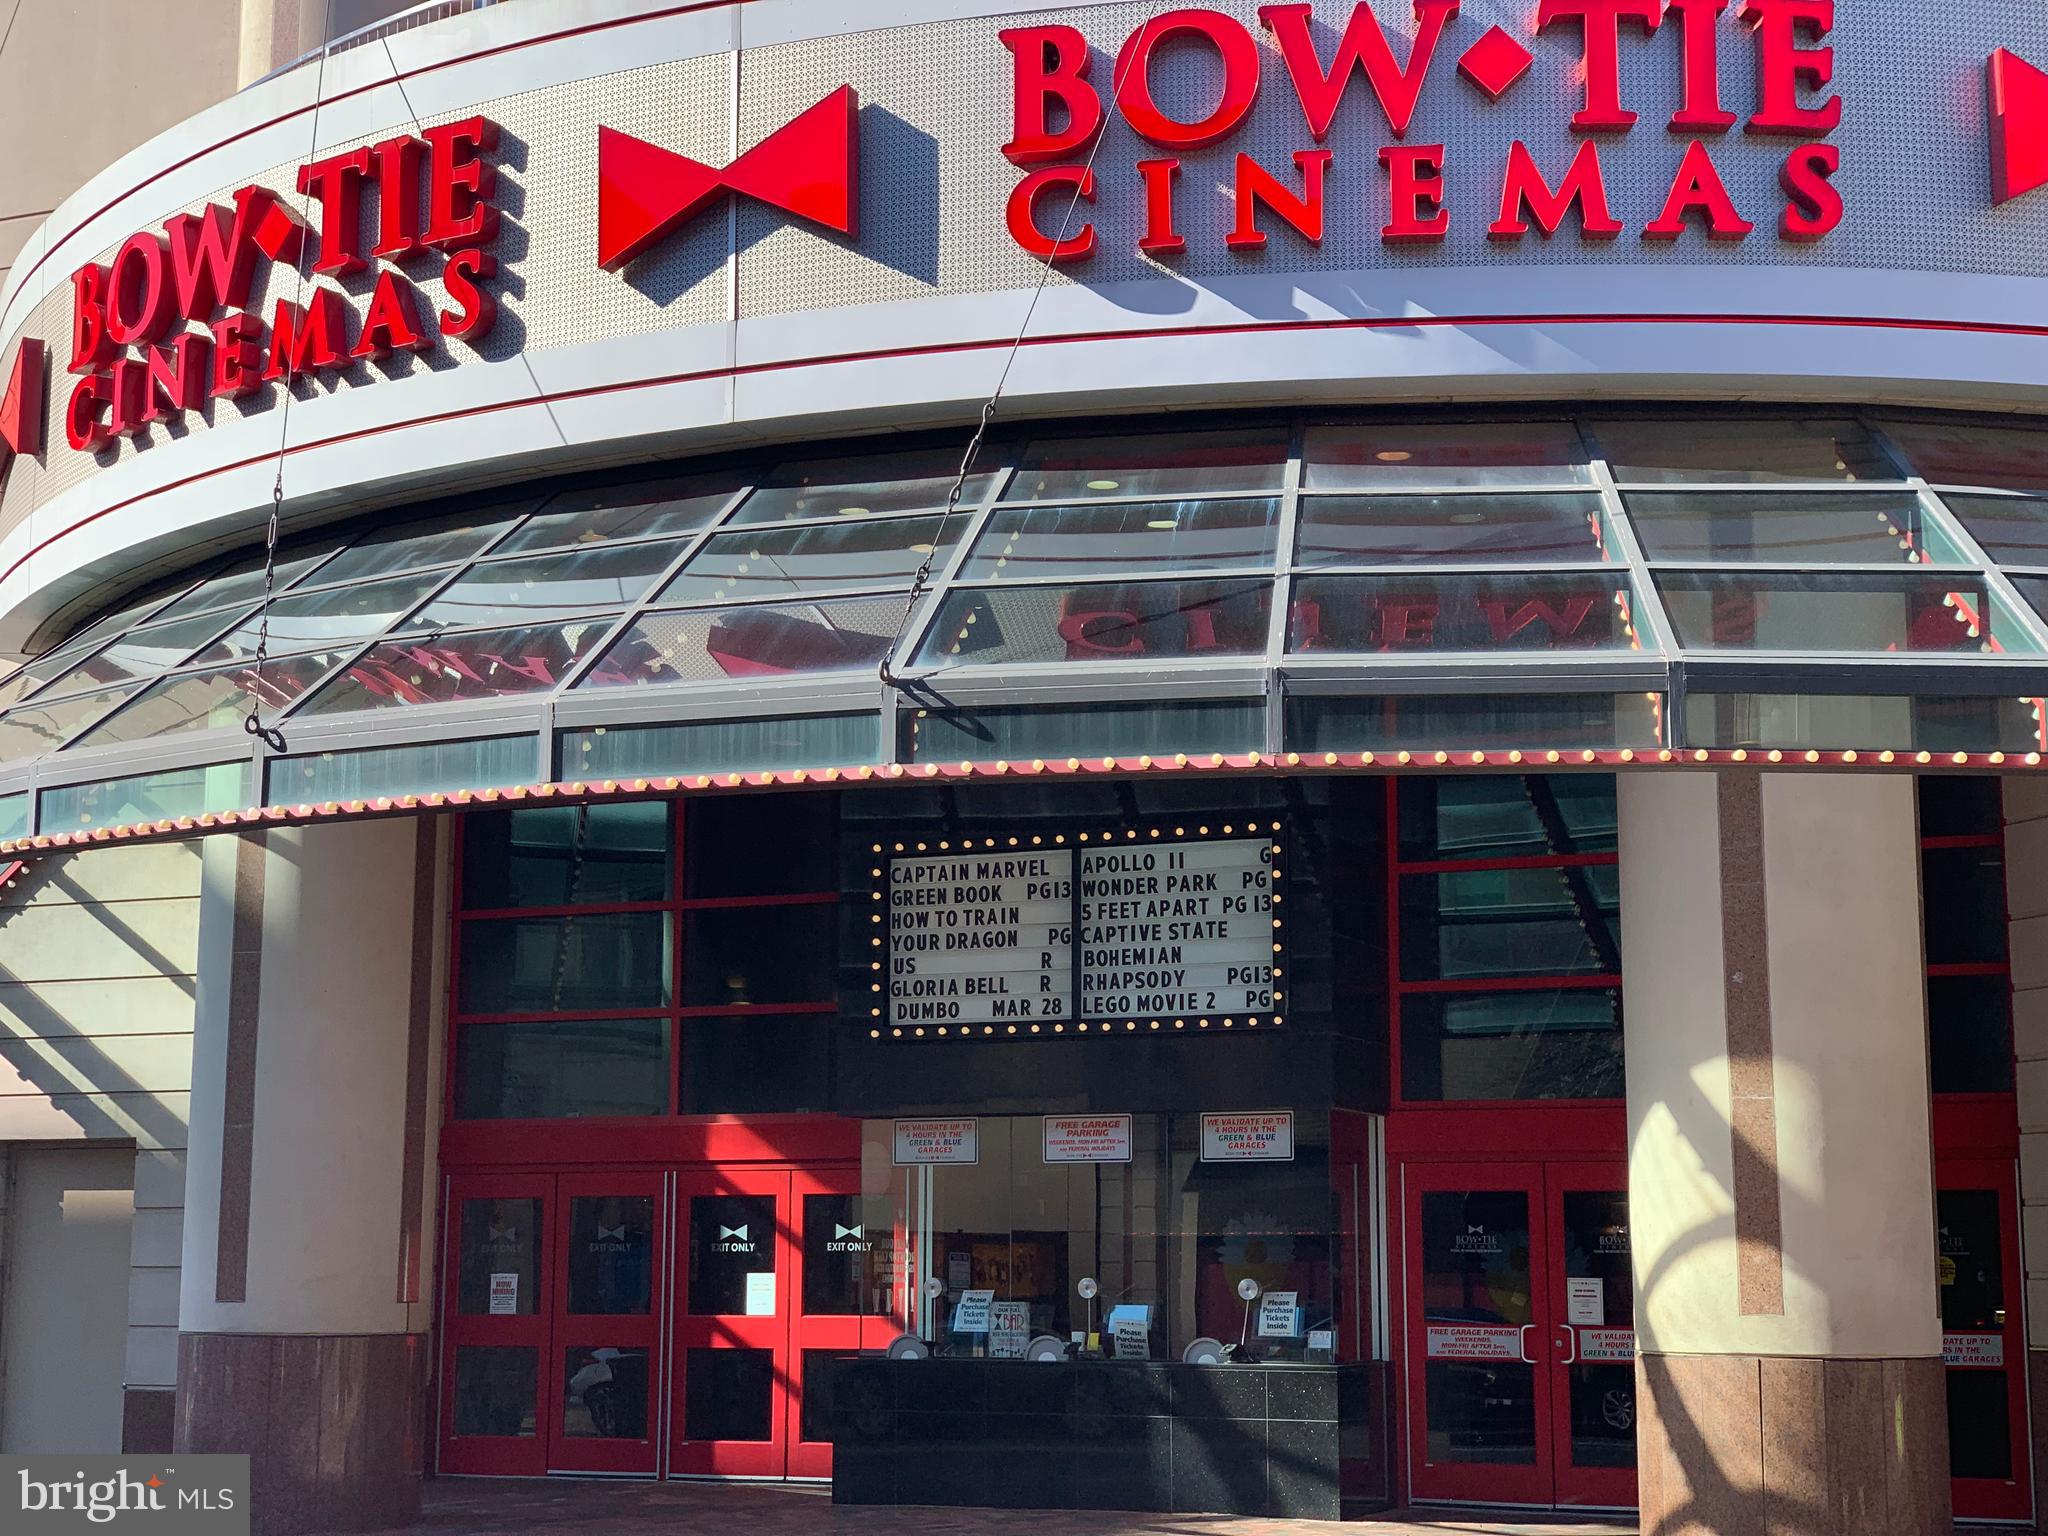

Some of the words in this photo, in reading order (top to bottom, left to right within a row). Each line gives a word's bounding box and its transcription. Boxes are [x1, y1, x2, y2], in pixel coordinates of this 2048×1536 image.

[1005, 139, 1843, 261] CINEMAS
[66, 249, 497, 452] CINEMAS
[1082, 853, 1156, 874] APOLLO
[1260, 846, 1272, 864] G
[891, 863, 969, 884] CAPTAIN
[977, 859, 1050, 880] MARVEL
[891, 887, 947, 906] GREEN
[954, 884, 1002, 904] BOOK
[1027, 881, 1071, 900] PG13
[1082, 876, 1159, 897] WONDER
[1167, 873, 1218, 893] PARK
[1242, 870, 1267, 889] PG
[891, 911, 929, 930] HOW
[935, 910, 958, 928] TO
[963, 907, 1019, 926] TRAIN
[1081, 904, 1092, 921] 5
[1097, 901, 1141, 920] FEET
[1146, 897, 1210, 918] APART
[1222, 895, 1247, 914] PG
[891, 934, 940, 951] YOUR
[946, 930, 1018, 949] DRAGON
[1048, 928, 1072, 945] PG
[1081, 924, 1161, 944] CAPTIVE
[1168, 920, 1228, 940] STATE
[894, 957, 916, 975] US
[1041, 952, 1052, 969] R
[1084, 946, 1182, 967] BOHEMIAN
[891, 979, 958, 997] GLORIA
[965, 976, 1009, 994] BELL
[1040, 975, 1051, 992] R
[1083, 969, 1186, 991] RHAPSODY
[1227, 966, 1272, 985] PG13
[897, 1001, 960, 1020] DUMBO
[992, 999, 1031, 1017] MAR
[1042, 998, 1062, 1015] 28
[1082, 995, 1130, 1014] LEGO
[1137, 992, 1198, 1012] MOVIE
[1206, 991, 1216, 1009] 2
[1246, 989, 1271, 1008] PG
[912, 1123, 949, 1131] VALIDATE
[950, 1123, 960, 1131] UP
[962, 1122, 972, 1130] TO
[1055, 1121, 1079, 1129] FREE
[1081, 1120, 1120, 1129] GARAGE
[1221, 1118, 1261, 1126] VALIDATE
[1263, 1117, 1274, 1125] UP
[1277, 1117, 1287, 1125] TO
[1066, 1129, 1109, 1137] PARKING
[1255, 1133, 1276, 1141] BLUE
[1228, 1141, 1266, 1149] GARAGES
[711, 1242, 729, 1251] EXIT
[731, 1242, 755, 1252] ONLY
[827, 1242, 845, 1251] EXIT
[847, 1242, 873, 1251] ONLY
[1003, 1314, 1025, 1331] BAR
[1120, 1328, 1142, 1336] Please
[1583, 1349, 1608, 1357] GREEN
